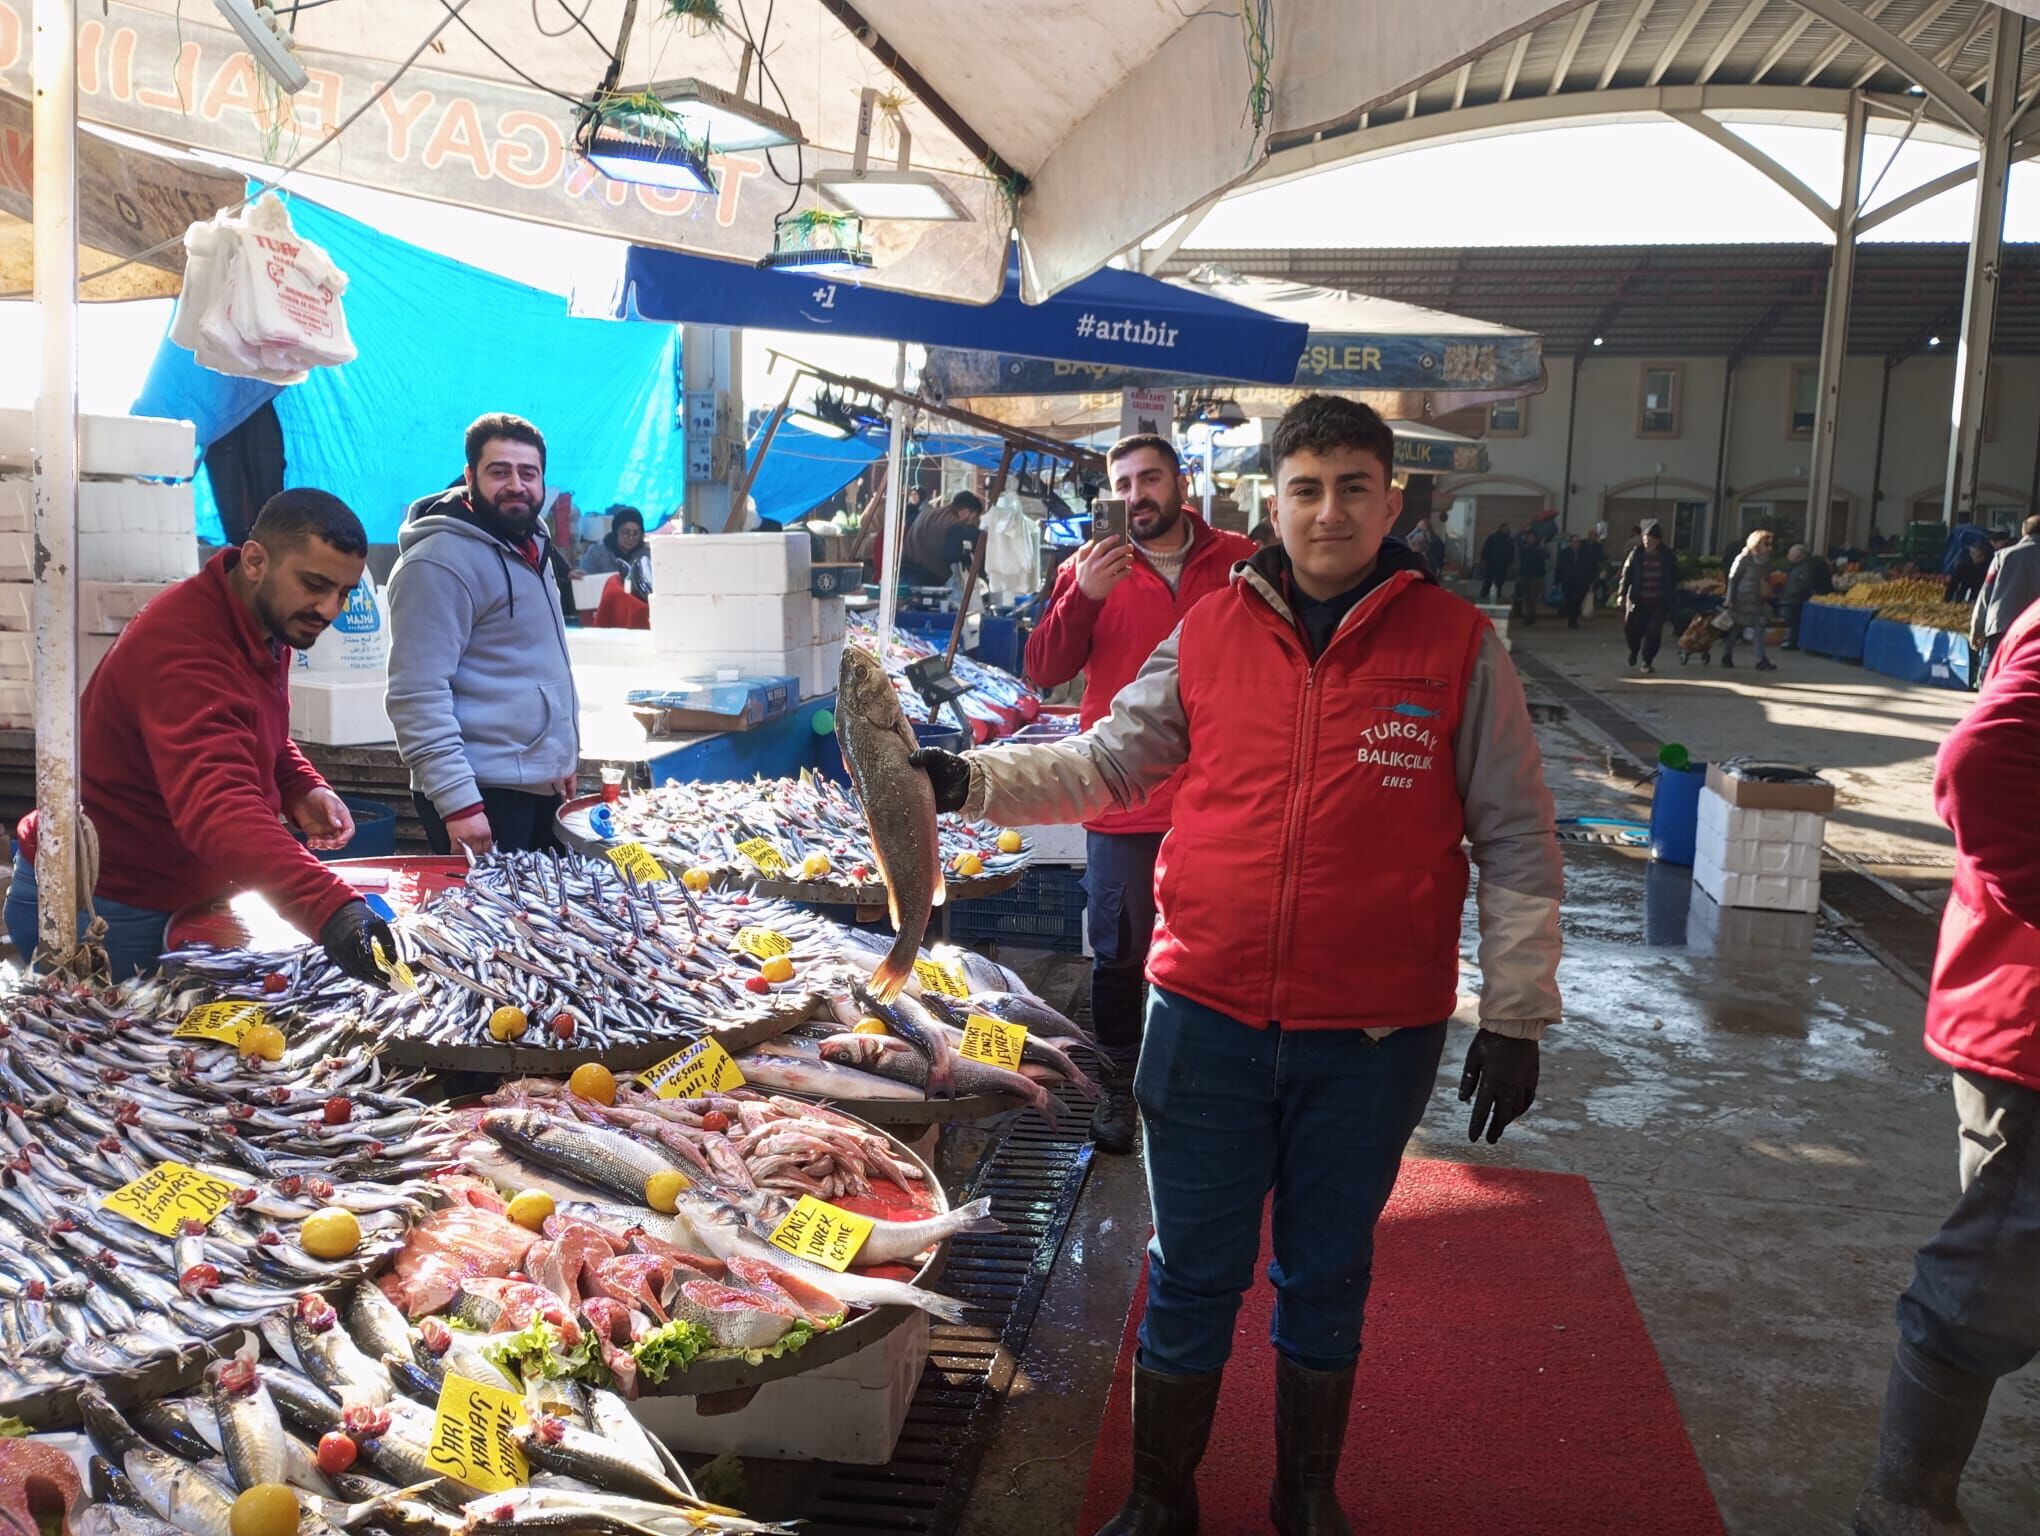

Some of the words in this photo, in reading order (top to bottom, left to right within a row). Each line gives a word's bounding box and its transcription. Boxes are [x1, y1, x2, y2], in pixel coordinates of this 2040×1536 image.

[812, 284, 836, 308] +1
[1076, 313, 1179, 348] #artıbir
[1360, 721, 1438, 751] TURGAY
[1357, 748, 1433, 770] BALIKÇILIK
[1382, 776, 1413, 789] ENES
[678, 1074, 708, 1099] ANLI
[176, 1180, 231, 1216] 200
[806, 1213, 838, 1258] LEVREK
[430, 1414, 468, 1479] SARI
[468, 1391, 497, 1477] KANAT
